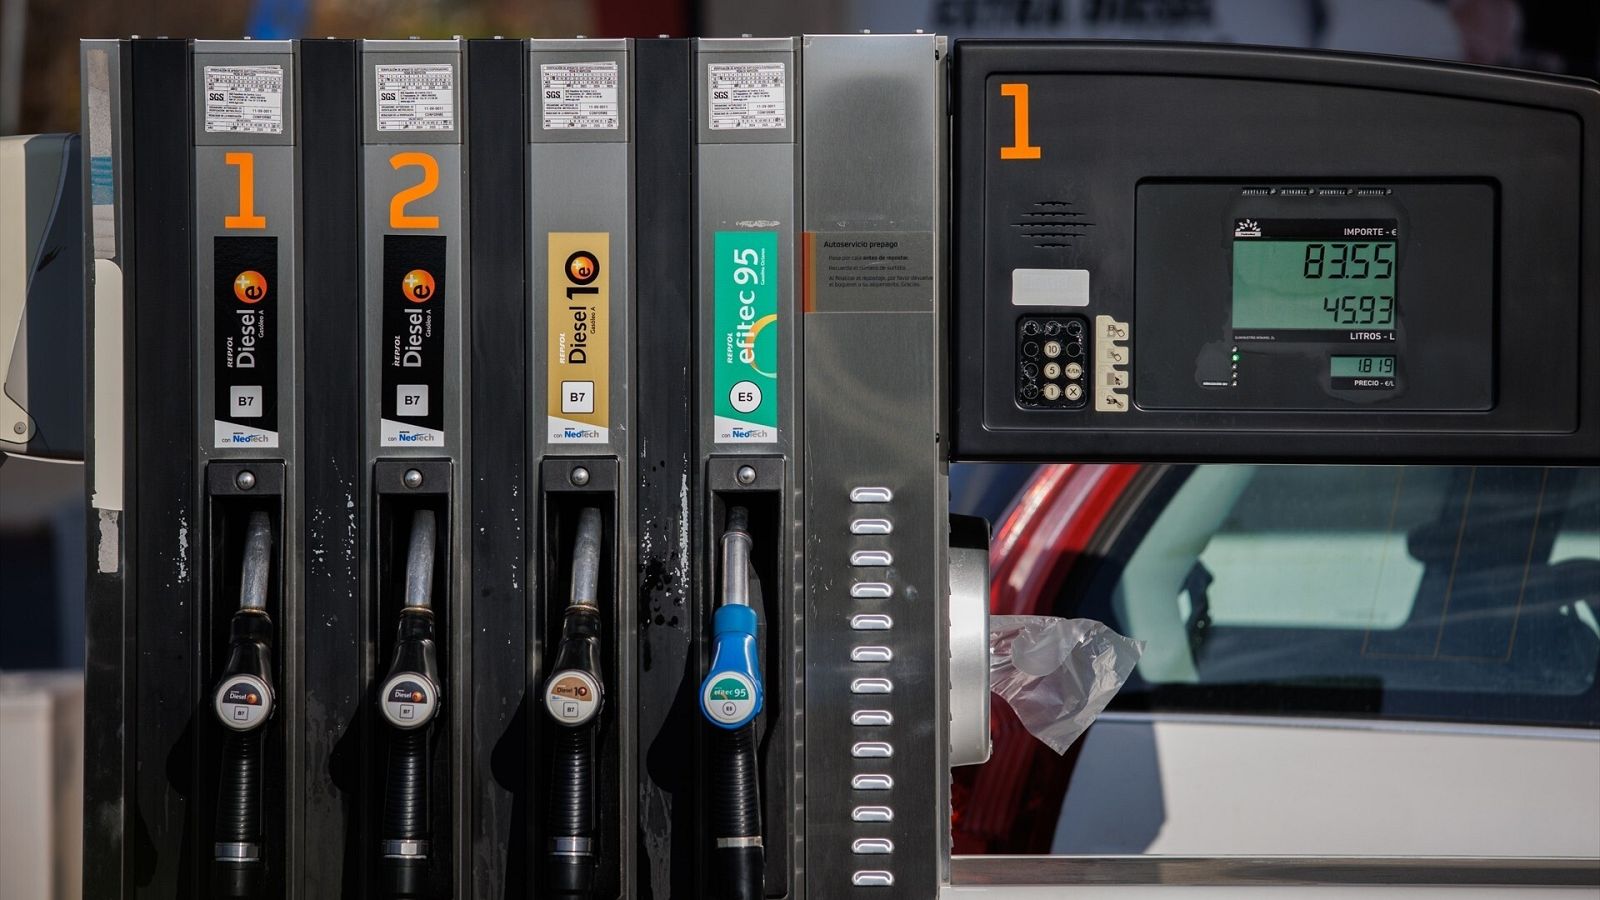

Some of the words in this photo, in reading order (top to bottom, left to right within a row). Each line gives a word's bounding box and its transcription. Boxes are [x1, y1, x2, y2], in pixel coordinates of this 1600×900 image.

[209, 93, 224, 101] SGS
[381, 93, 396, 101] SGS
[546, 91, 561, 99] SGS
[1000, 83, 1041, 160] 1
[224, 153, 267, 229] 1
[388, 152, 440, 228] 2
[1391, 228, 1397, 236] €
[869, 241, 898, 249] prepago
[733, 248, 758, 285] 95
[1303, 244, 1393, 279] 83.55
[564, 250, 600, 300] 10
[1323, 296, 1394, 325] 45.93
[736, 291, 755, 364] efitec
[236, 309, 255, 369] Diesel
[403, 308, 422, 368] Diesel
[568, 307, 587, 365] Diesel
[1350, 332, 1381, 340] LITROS
[1390, 332, 1395, 340] L
[726, 332, 734, 363] REPSOL
[1048, 345, 1058, 353] 10
[1049, 367, 1055, 375] 5
[1358, 359, 1393, 373] 1.819
[238, 397, 254, 406] B7
[404, 396, 420, 405] B7
[570, 393, 585, 402] B7
[738, 392, 753, 402] E5
[734, 688, 746, 698] 95
